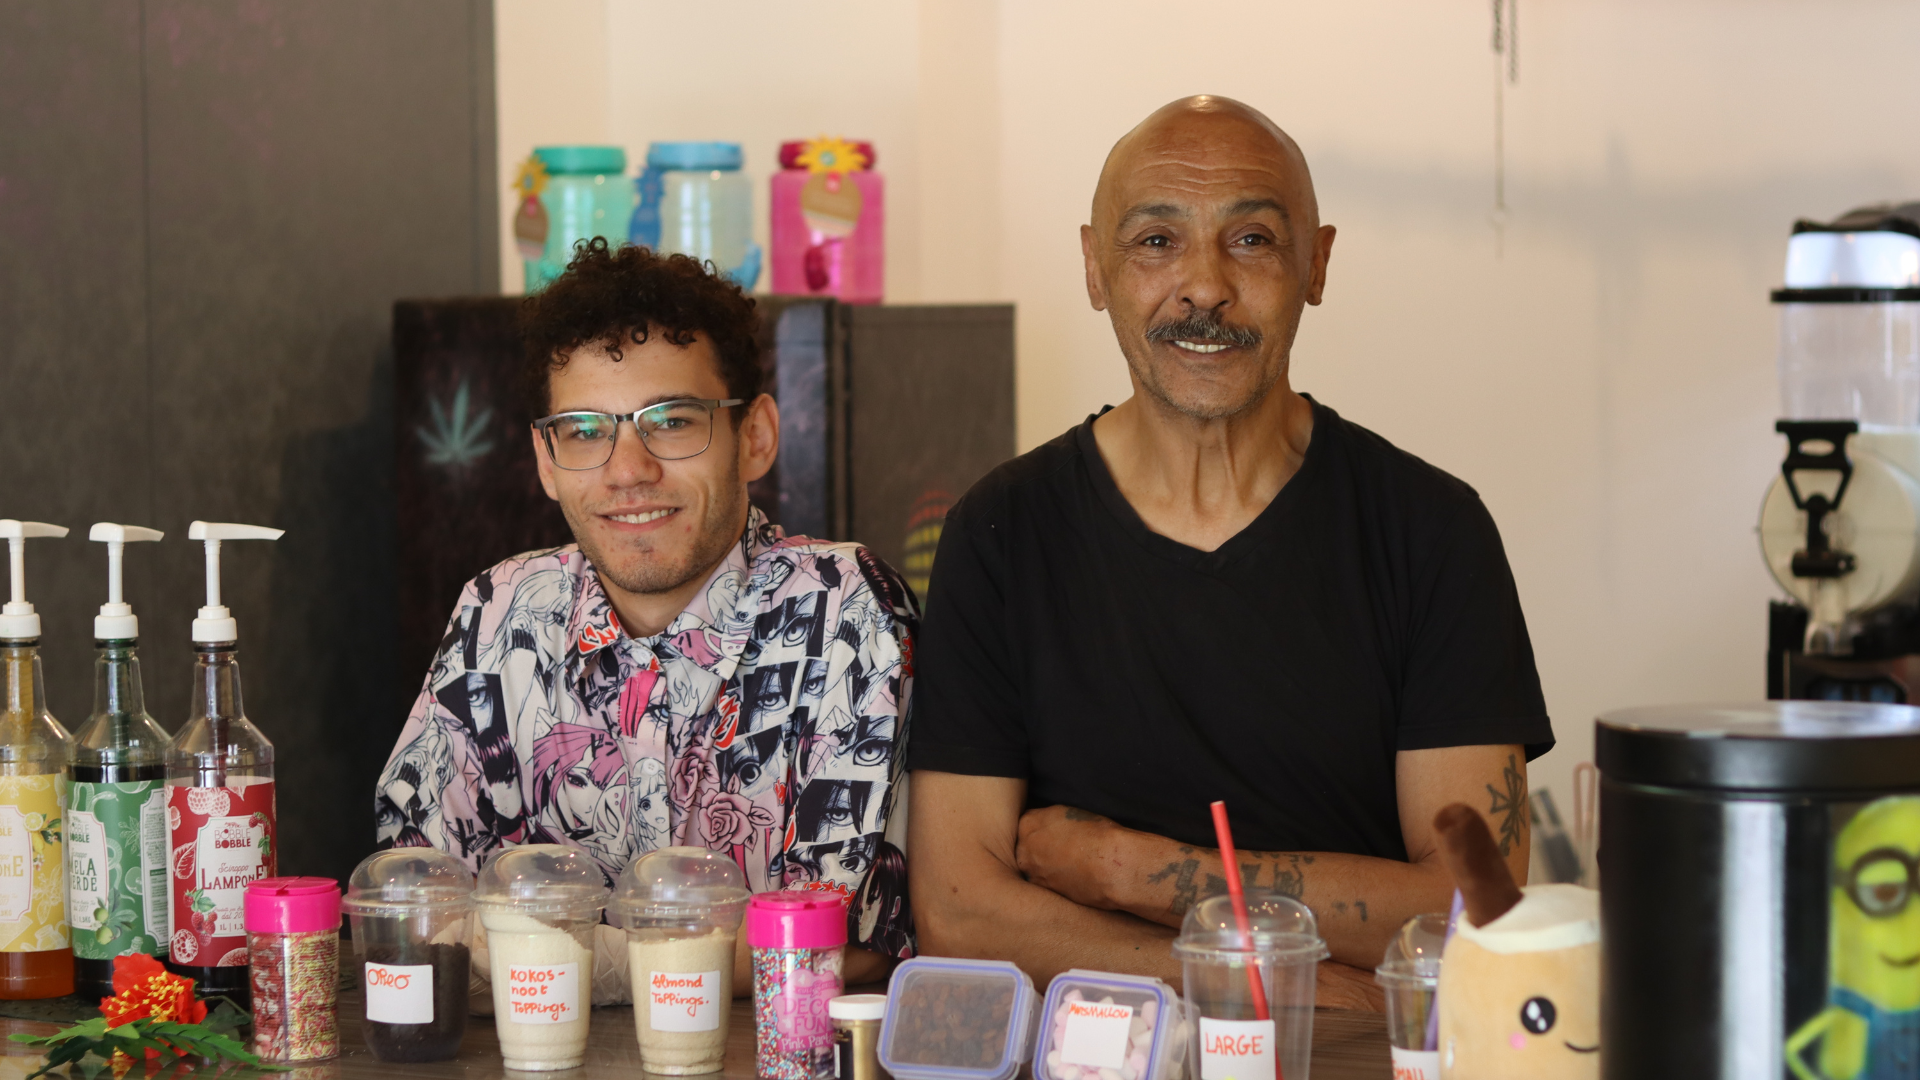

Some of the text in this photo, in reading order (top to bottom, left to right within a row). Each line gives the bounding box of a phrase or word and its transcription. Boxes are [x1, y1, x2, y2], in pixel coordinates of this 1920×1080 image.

[215, 838, 251, 849] BOBBLE
[72, 876, 98, 892] ERDE
[652, 974, 704, 989] Almond
[794, 1016, 827, 1034] FUN
[781, 1037, 806, 1050] Pink
[1204, 1032, 1264, 1056] LARGE
